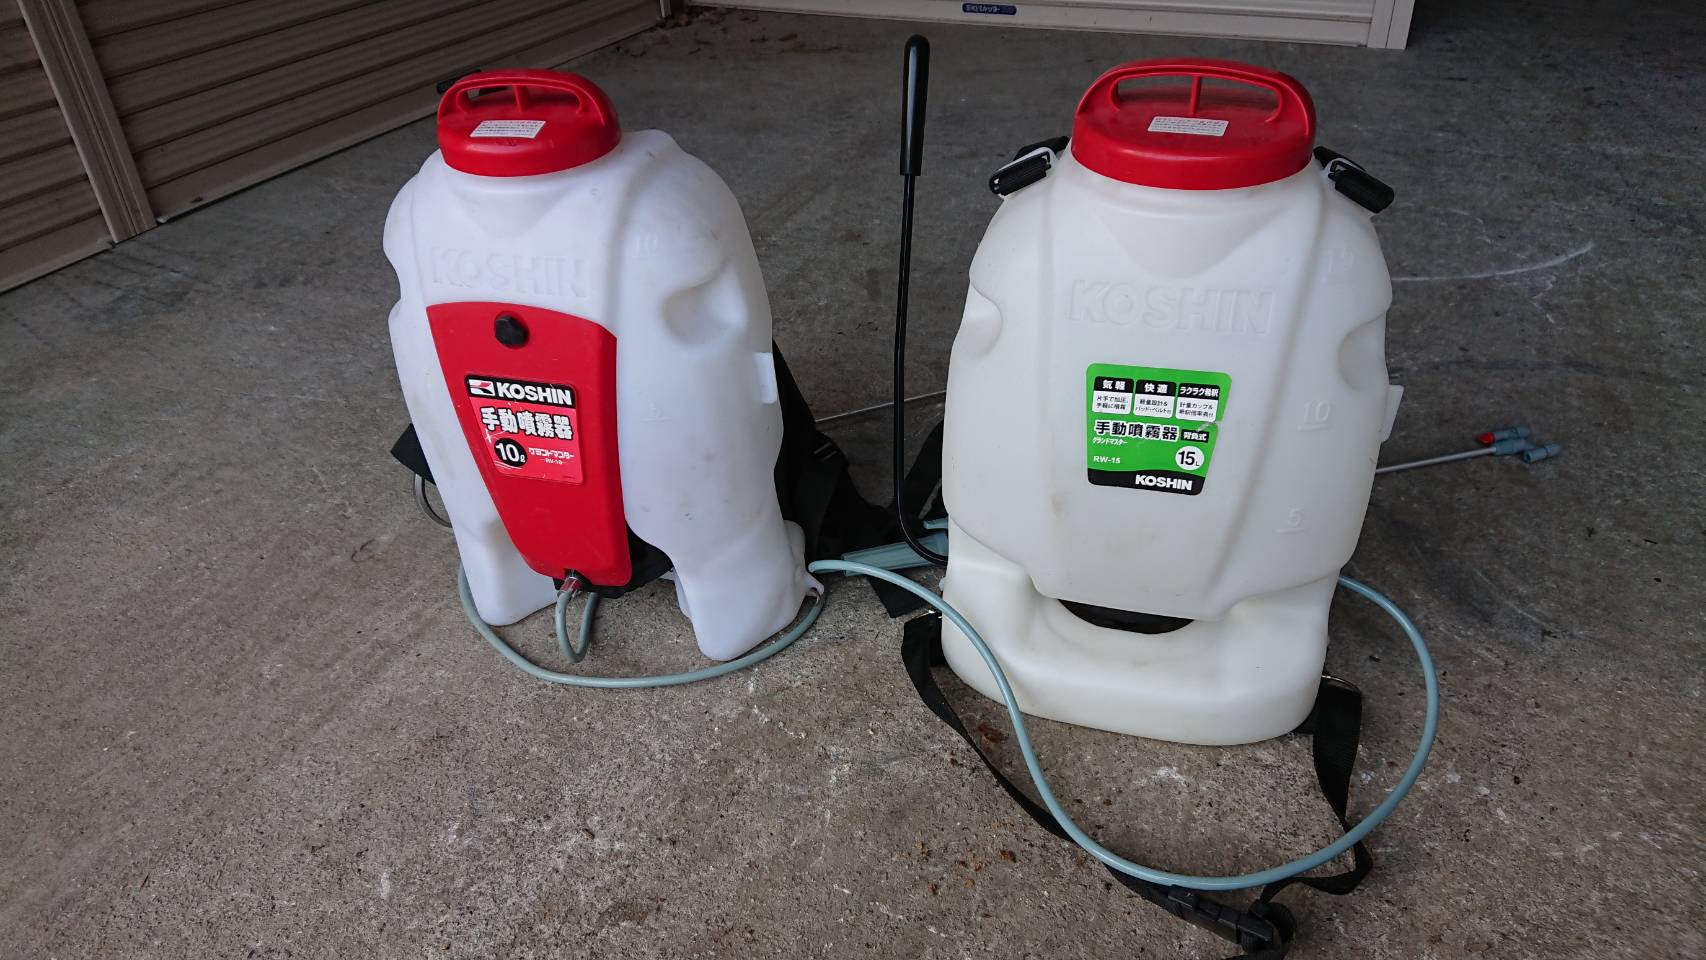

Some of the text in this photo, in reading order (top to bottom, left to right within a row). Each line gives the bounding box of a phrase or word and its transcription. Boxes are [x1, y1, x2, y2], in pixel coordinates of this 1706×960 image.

[432, 247, 588, 297] KOSHIN
[1069, 279, 1275, 335] KOSHIN
[496, 382, 573, 405] KOSHIN
[1302, 401, 1331, 422] 10
[480, 407, 573, 440] 手動噴霧器
[1096, 421, 1178, 441] 手動噴霧器
[1093, 455, 1121, 464] RW-15
[1135, 474, 1193, 491] KOSHIN
